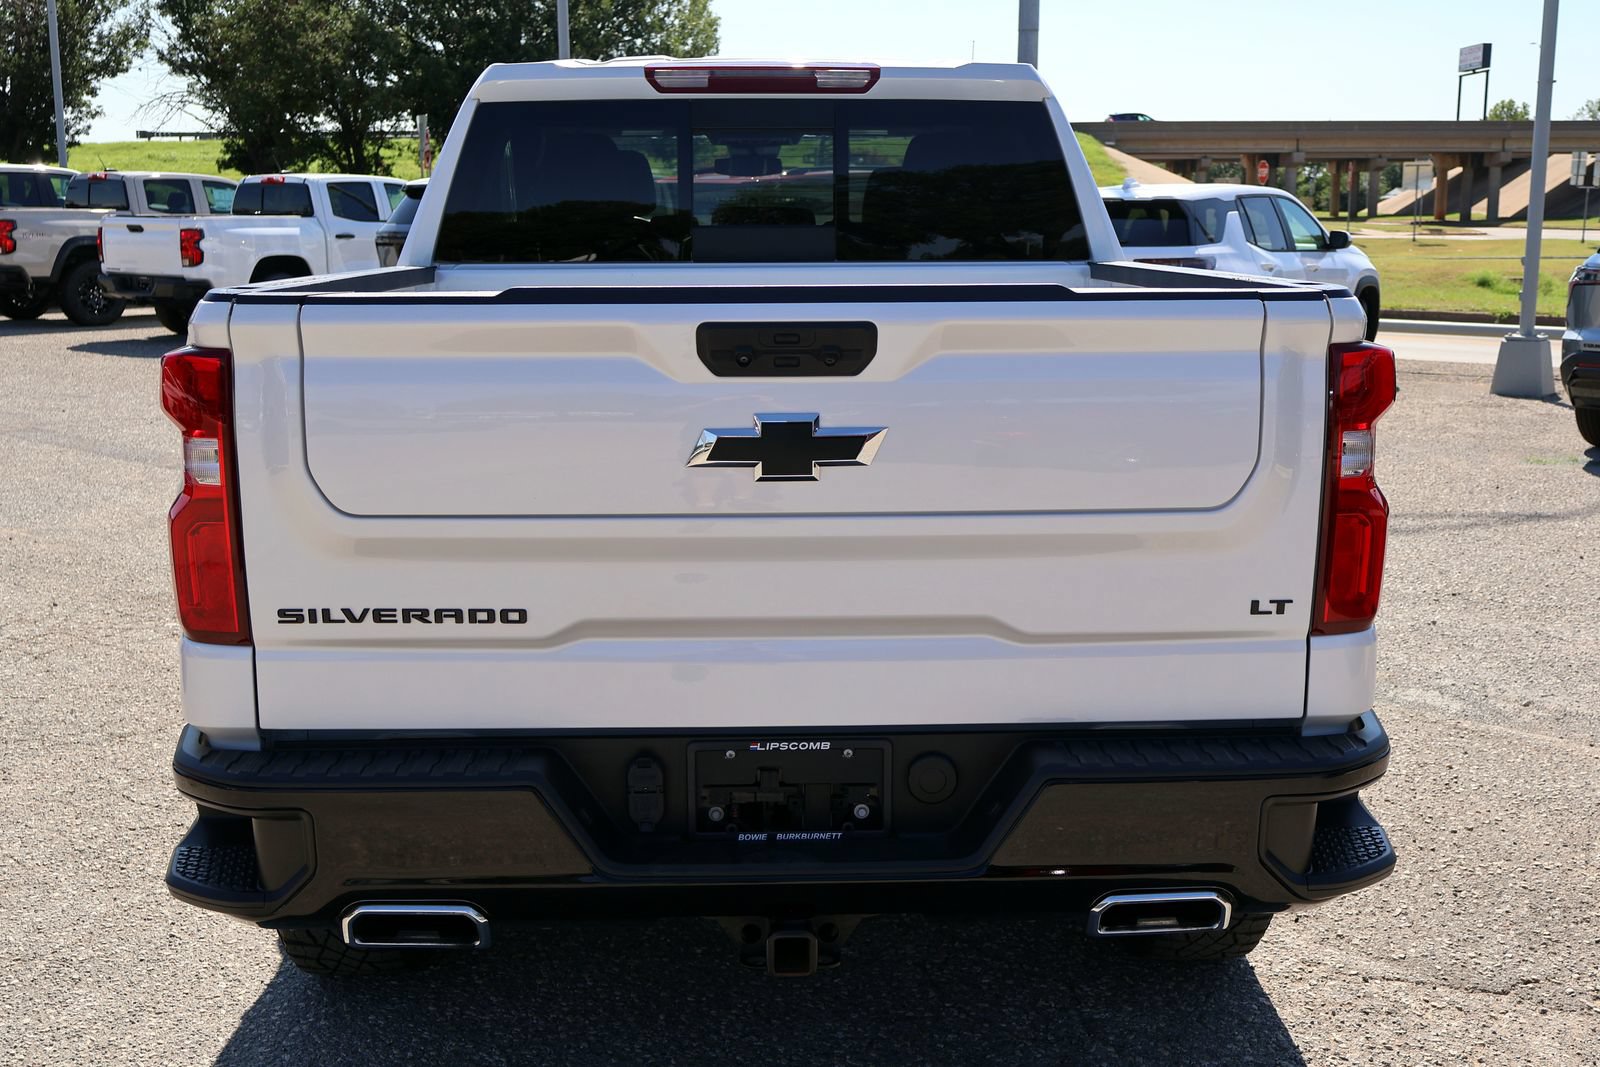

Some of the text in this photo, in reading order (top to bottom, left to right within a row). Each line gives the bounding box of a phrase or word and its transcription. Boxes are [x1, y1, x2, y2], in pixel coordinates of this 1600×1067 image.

[1250, 599, 1294, 615] LT
[277, 608, 528, 624] SILVERADO
[756, 741, 831, 751] LIPSCOMB
[738, 832, 843, 841] BOWIE BURKBURNETT
